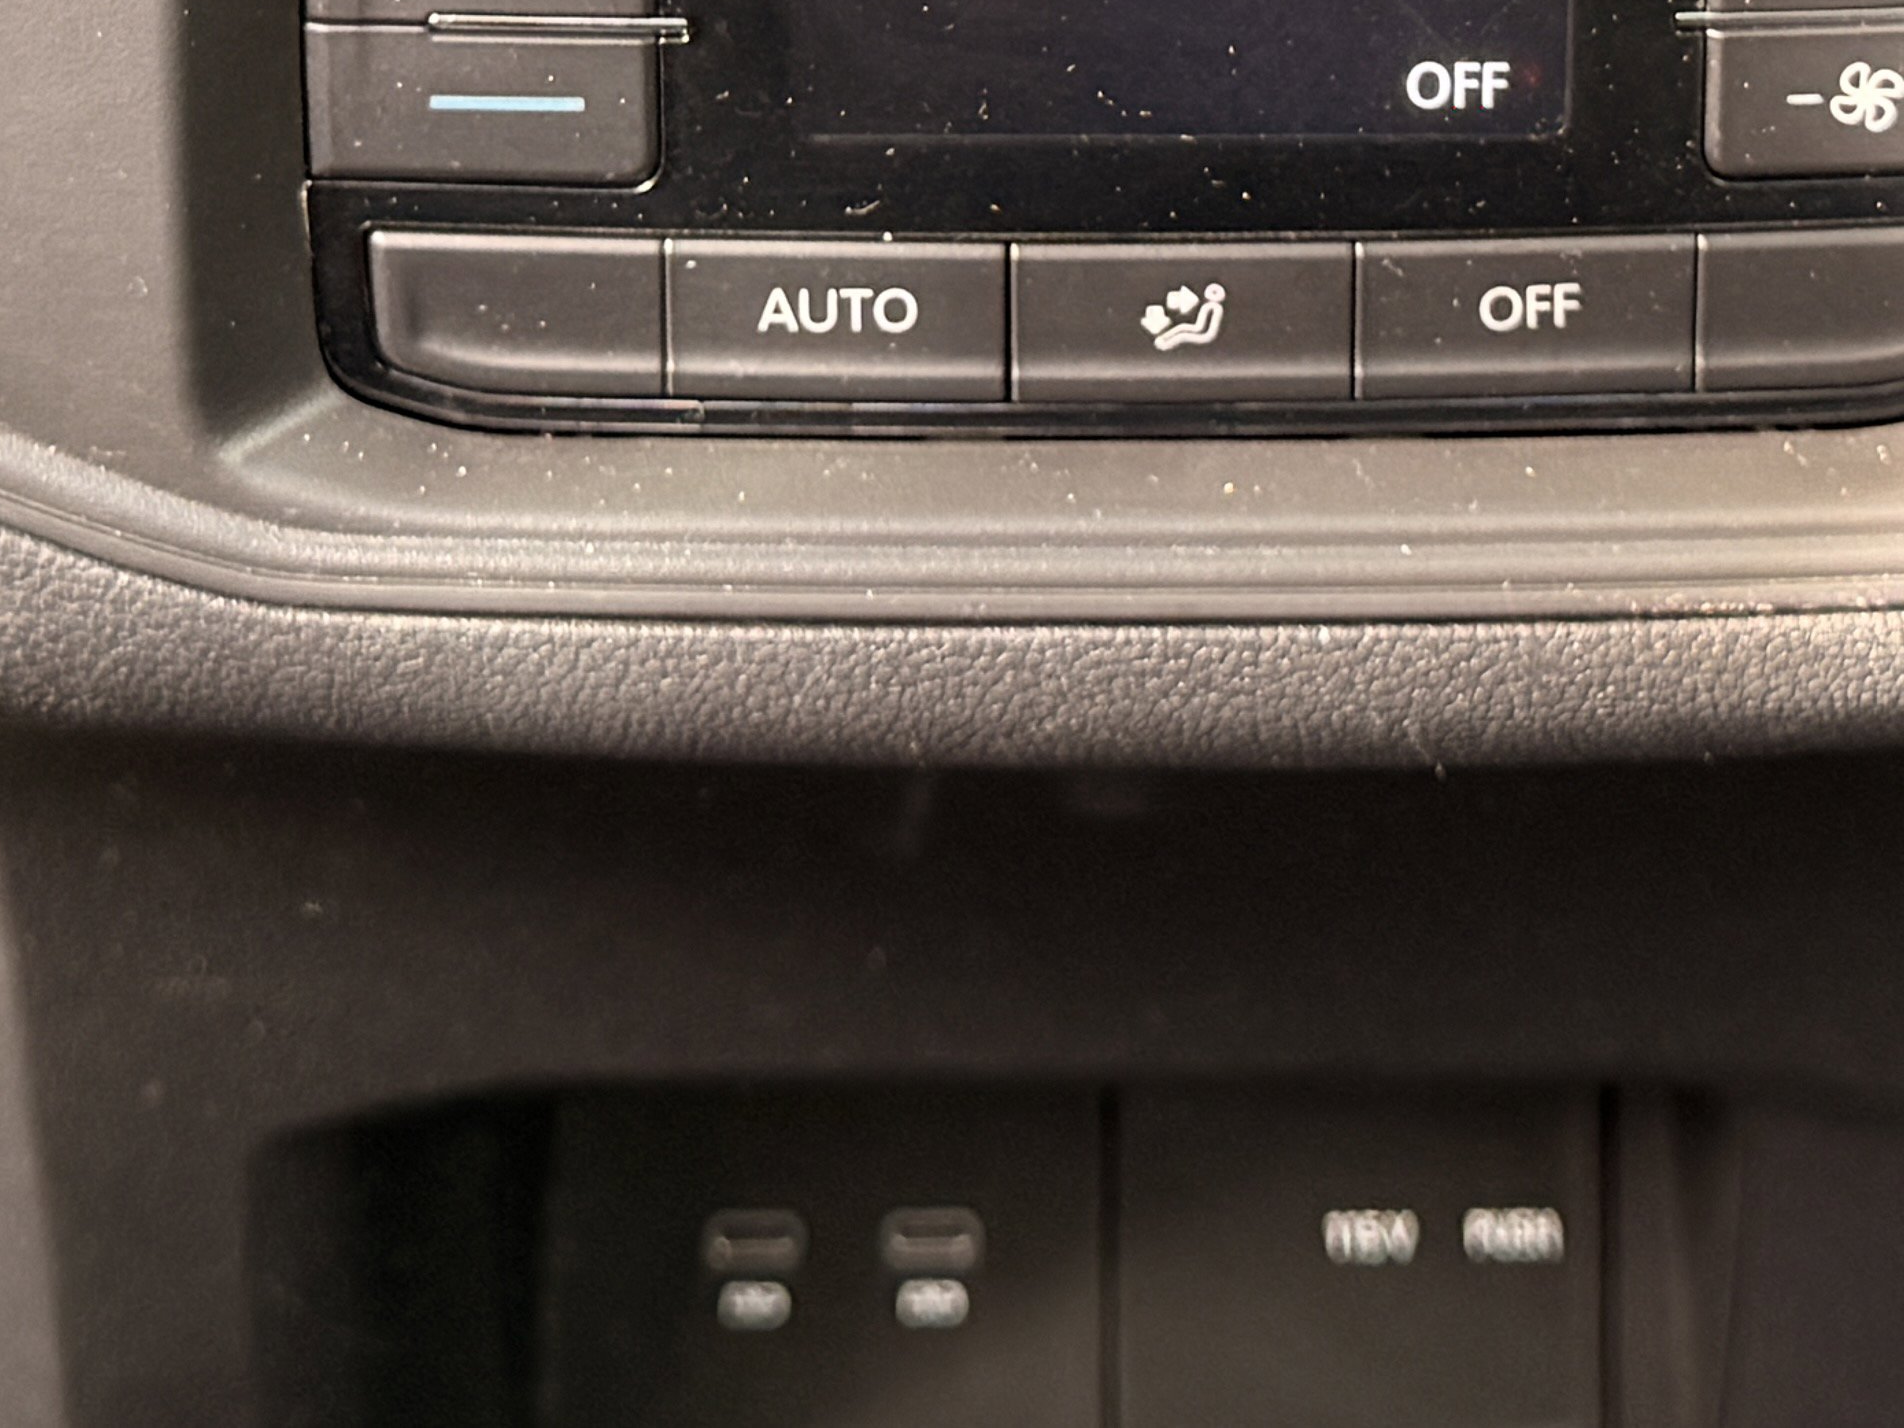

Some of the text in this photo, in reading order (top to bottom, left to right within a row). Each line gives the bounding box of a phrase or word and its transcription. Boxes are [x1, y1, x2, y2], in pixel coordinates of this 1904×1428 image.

[1404, 59, 1512, 111] OFF
[756, 285, 920, 335] AUTO
[1477, 281, 1582, 333] OFF
